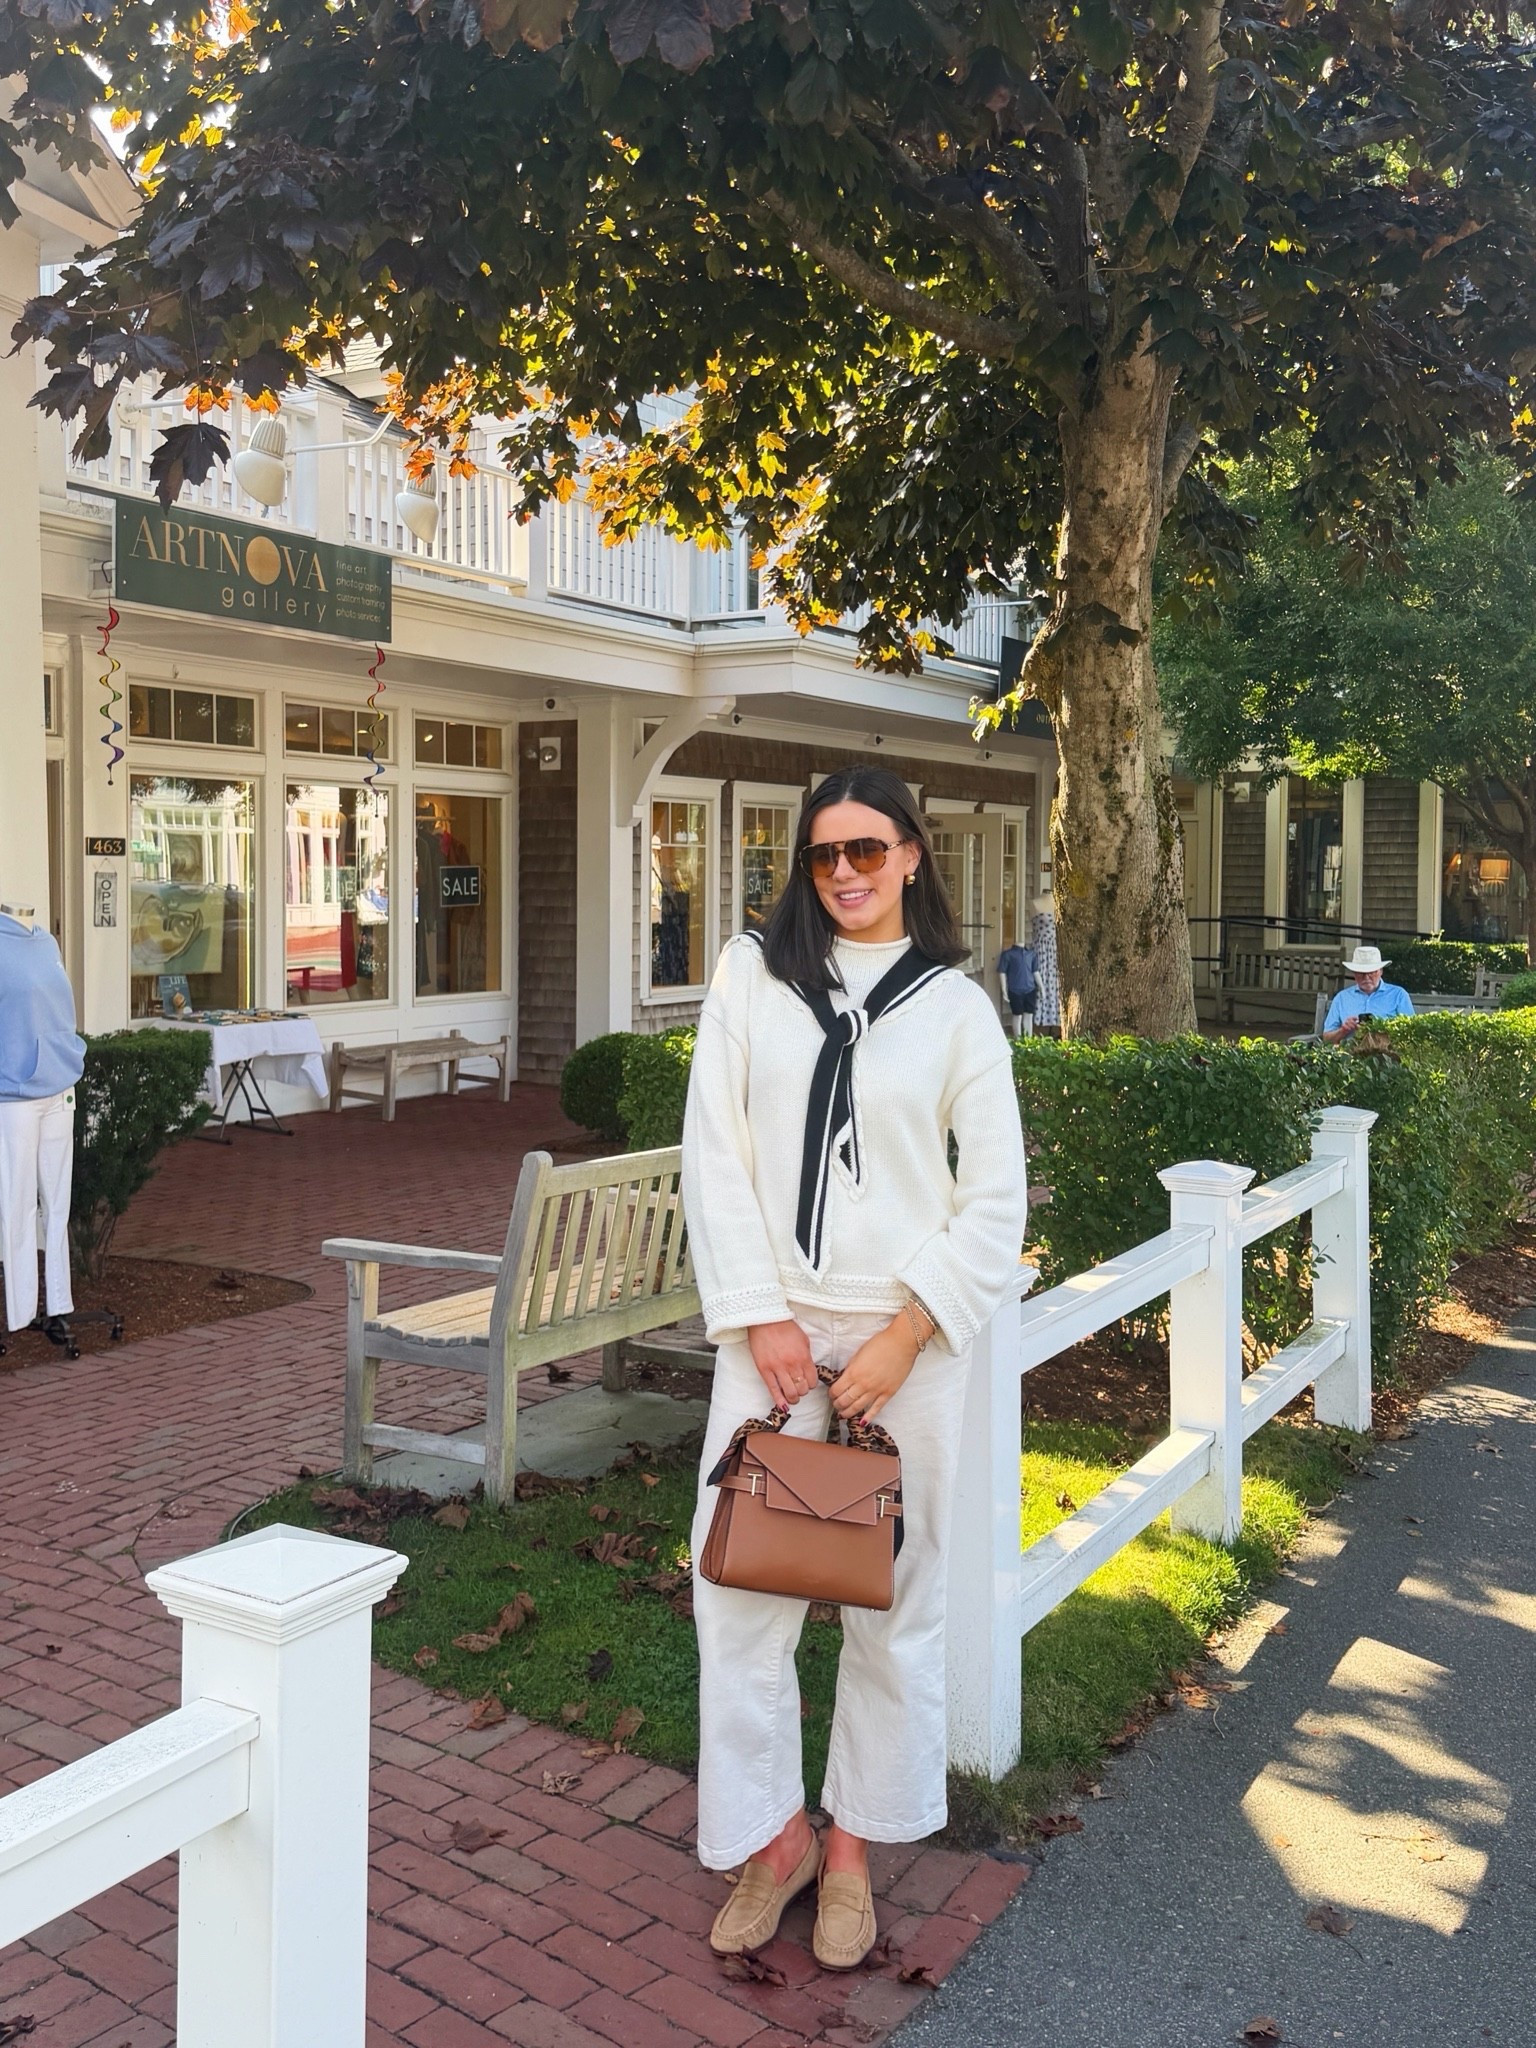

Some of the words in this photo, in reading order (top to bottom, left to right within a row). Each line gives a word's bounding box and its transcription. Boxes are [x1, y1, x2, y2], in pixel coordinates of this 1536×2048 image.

[129, 516, 329, 593] ARTNOVA
[336, 560, 352, 571] fine
[355, 566, 367, 574] art
[336, 577, 383, 595] photography
[221, 586, 327, 623] gallery
[93, 840, 122, 854] 463
[442, 876, 478, 897] SALE
[748, 877, 772, 894] SALE
[100, 879, 112, 926] OPEN
